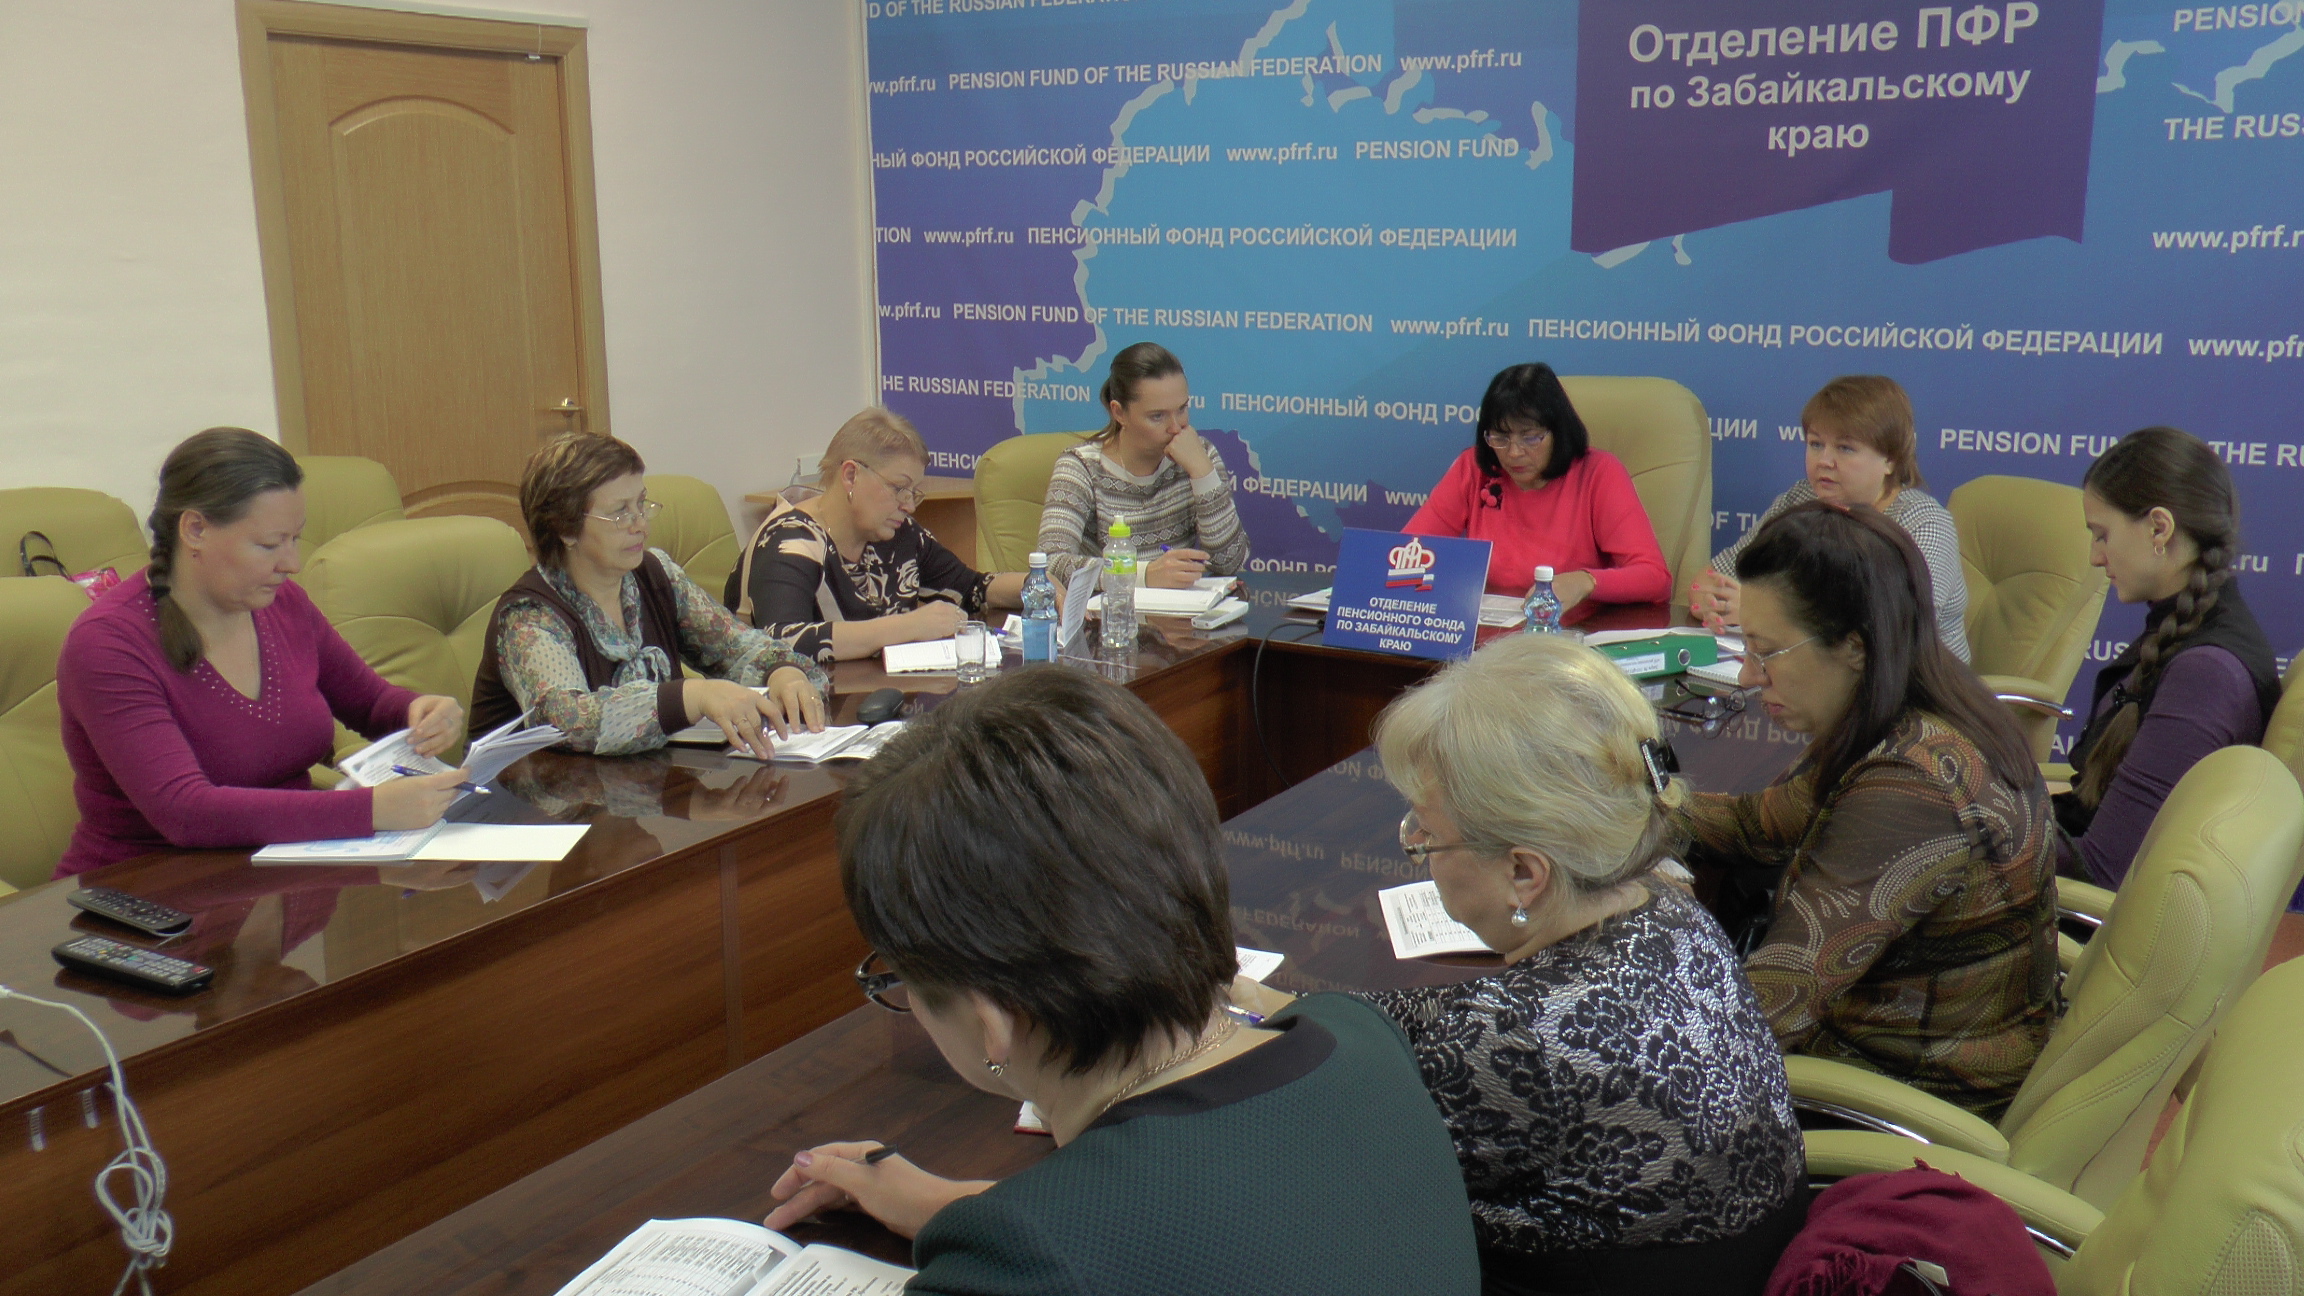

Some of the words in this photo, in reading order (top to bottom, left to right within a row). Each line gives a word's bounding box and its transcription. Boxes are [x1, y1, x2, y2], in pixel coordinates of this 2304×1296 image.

[885, 1, 907, 17] OF
[911, 0, 944, 15] THE
[950, 0, 1025, 13] RUSSIAN
[1628, 20, 1898, 66] Отделение
[1917, 1, 2039, 49] ПФР
[949, 71, 1025, 90] PENSION
[1030, 67, 1079, 86] FUND
[1084, 67, 1109, 84] OF
[1115, 64, 1151, 82] THE
[1157, 60, 1243, 81] RUSSIAN
[1250, 54, 1382, 77] FEDERATION
[1400, 49, 1522, 72] www.pfrf.ru
[1630, 83, 1675, 109] по
[1686, 69, 2032, 108] Забайкальскому
[1767, 123, 1870, 157] краю
[2164, 116, 2225, 141] THE
[2234, 112, 2304, 139] RUS
[911, 150, 961, 170] ФОНД
[965, 144, 1086, 167] РОССИЙСКОЙ
[1092, 145, 1210, 166] ФЕДЕРАЦИИ
[1227, 143, 1338, 165] www.pfrf.ru
[1355, 139, 1451, 160] PENSION
[1458, 138, 1519, 158] FUND
[923, 227, 1014, 247] www.pfrf.ru
[1028, 223, 1160, 245] ПЕНСИОННЫЙ
[1166, 227, 1224, 248] ФОНД
[1229, 223, 1373, 246] РОССИЙСКОЙ
[1379, 228, 1517, 250] ФЕДЕРАЦИИ
[953, 303, 1026, 321] PENSION
[1031, 306, 1079, 323] FUND
[1084, 307, 1108, 325] OF
[1113, 307, 1149, 326] THE
[1154, 308, 1238, 328] RUSSIAN
[1244, 311, 1373, 332] FEDERATION
[1390, 317, 1509, 339] www.pfrf.ru
[1528, 318, 1700, 342] ПЕНСИОННЫЙ
[1707, 324, 1782, 348] ФОНД
[1789, 322, 1974, 350] РОССИЙСКОЙ
[1982, 329, 2163, 357] ФЕДЕРАЦИИ
[909, 376, 979, 395] RUSSIAN
[984, 380, 1090, 402] FEDERATION
[1221, 392, 1367, 418] ПЕНСИОННЫЙ
[1374, 401, 1438, 425] ФОНД
[1940, 428, 2061, 455] PENSION
[2207, 441, 2267, 466] THE
[1243, 476, 1367, 503] ФЕДЕРАЦИИ
[1336, 606, 1422, 626] ПЕНСИОННОГО
[1424, 618, 1466, 632] ФОНДА
[1369, 597, 1438, 615] ОТДЕЛЕНИЕ
[1336, 619, 1353, 631] ПО
[1354, 622, 1463, 645] ЗАБАЙКАЛЬСКОМУ
[1379, 638, 1412, 652] КРАЮ
